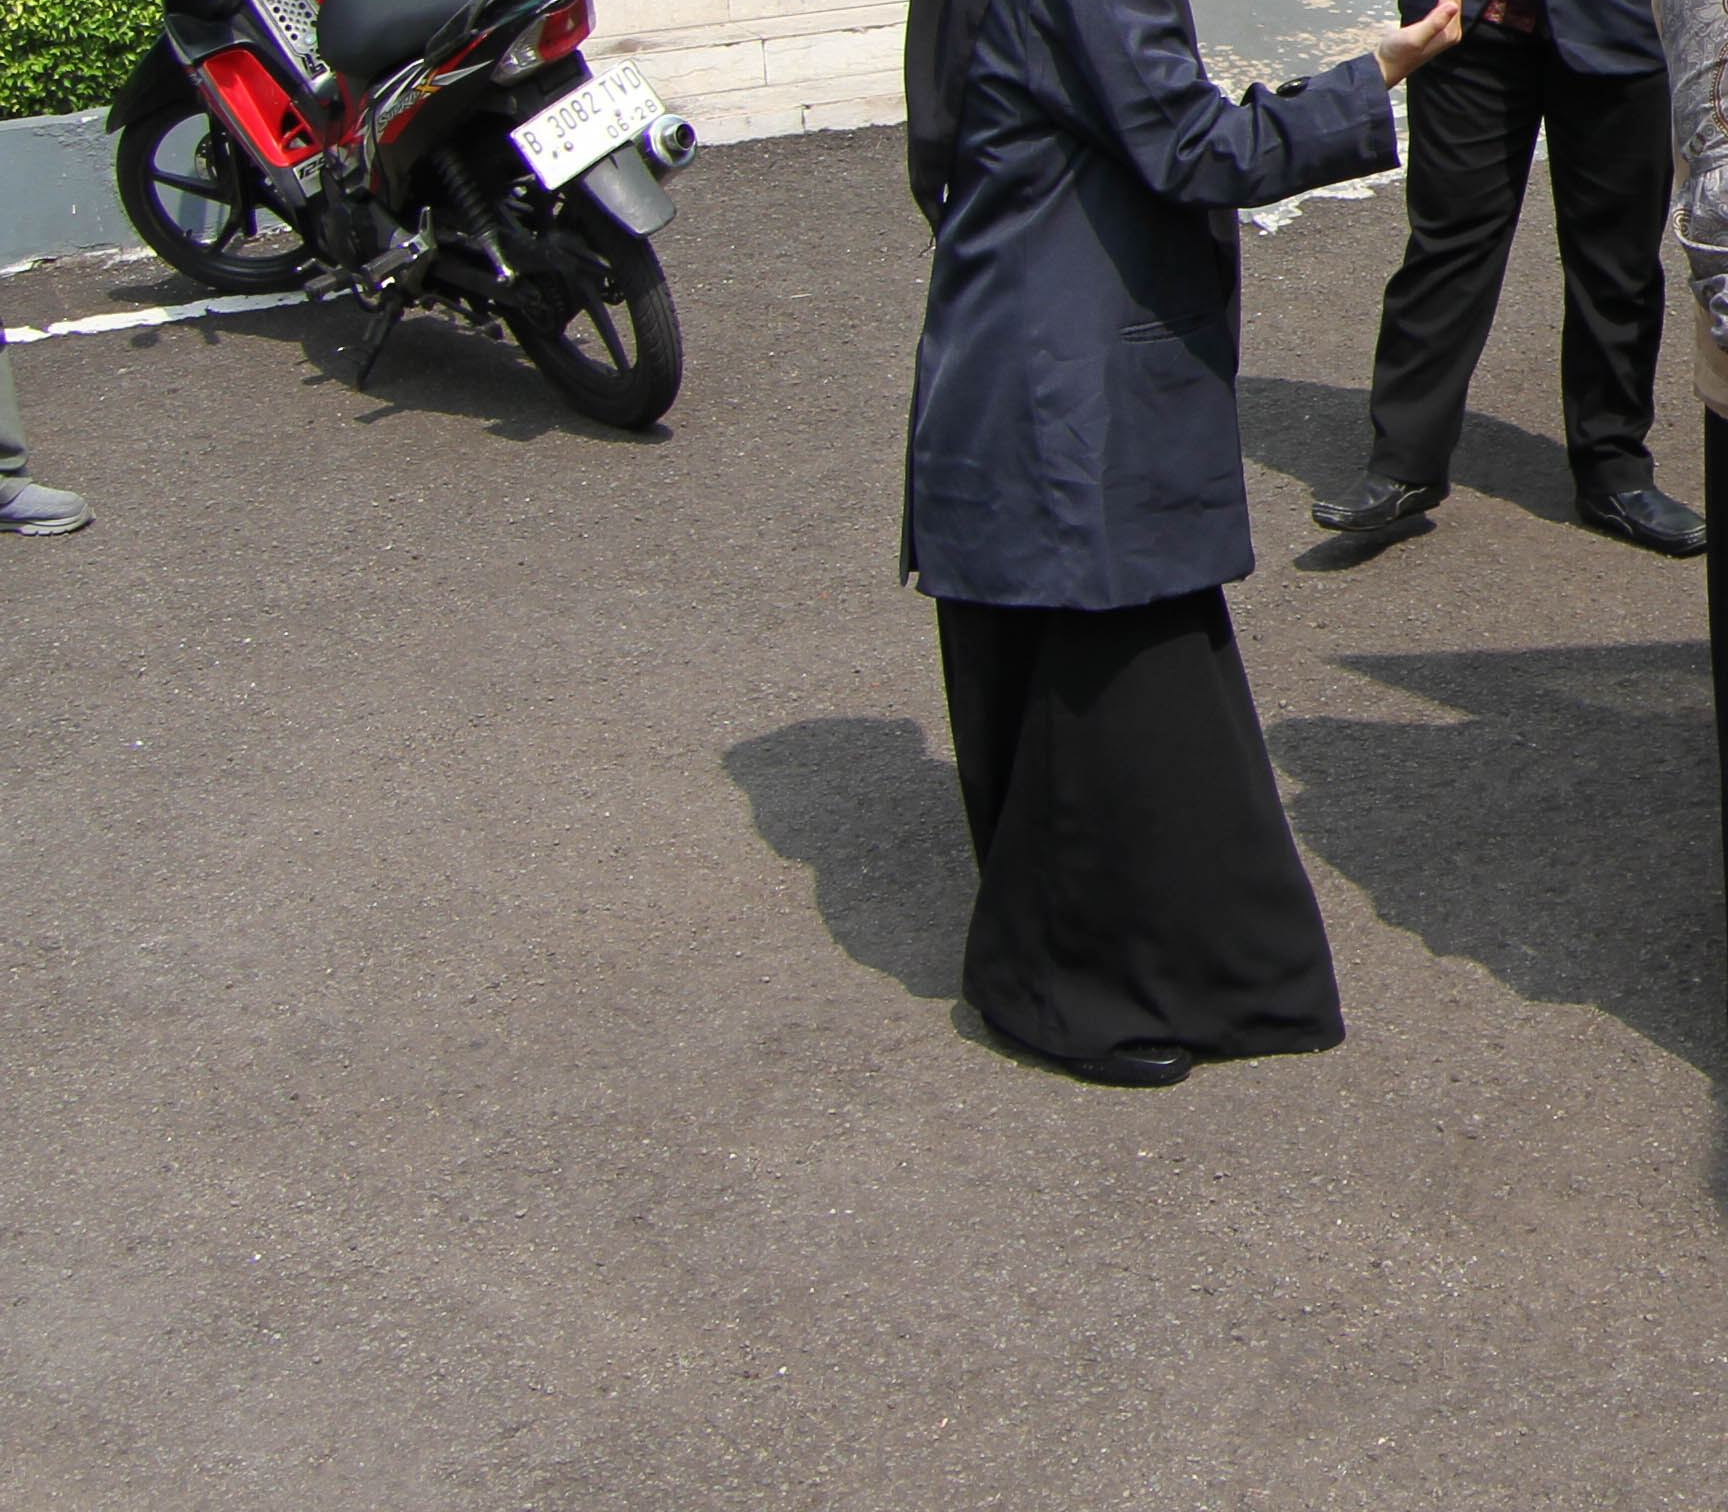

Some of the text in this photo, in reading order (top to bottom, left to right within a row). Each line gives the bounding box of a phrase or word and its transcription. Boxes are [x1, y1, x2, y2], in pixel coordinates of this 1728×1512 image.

[523, 66, 642, 156] B 3082 TVD
